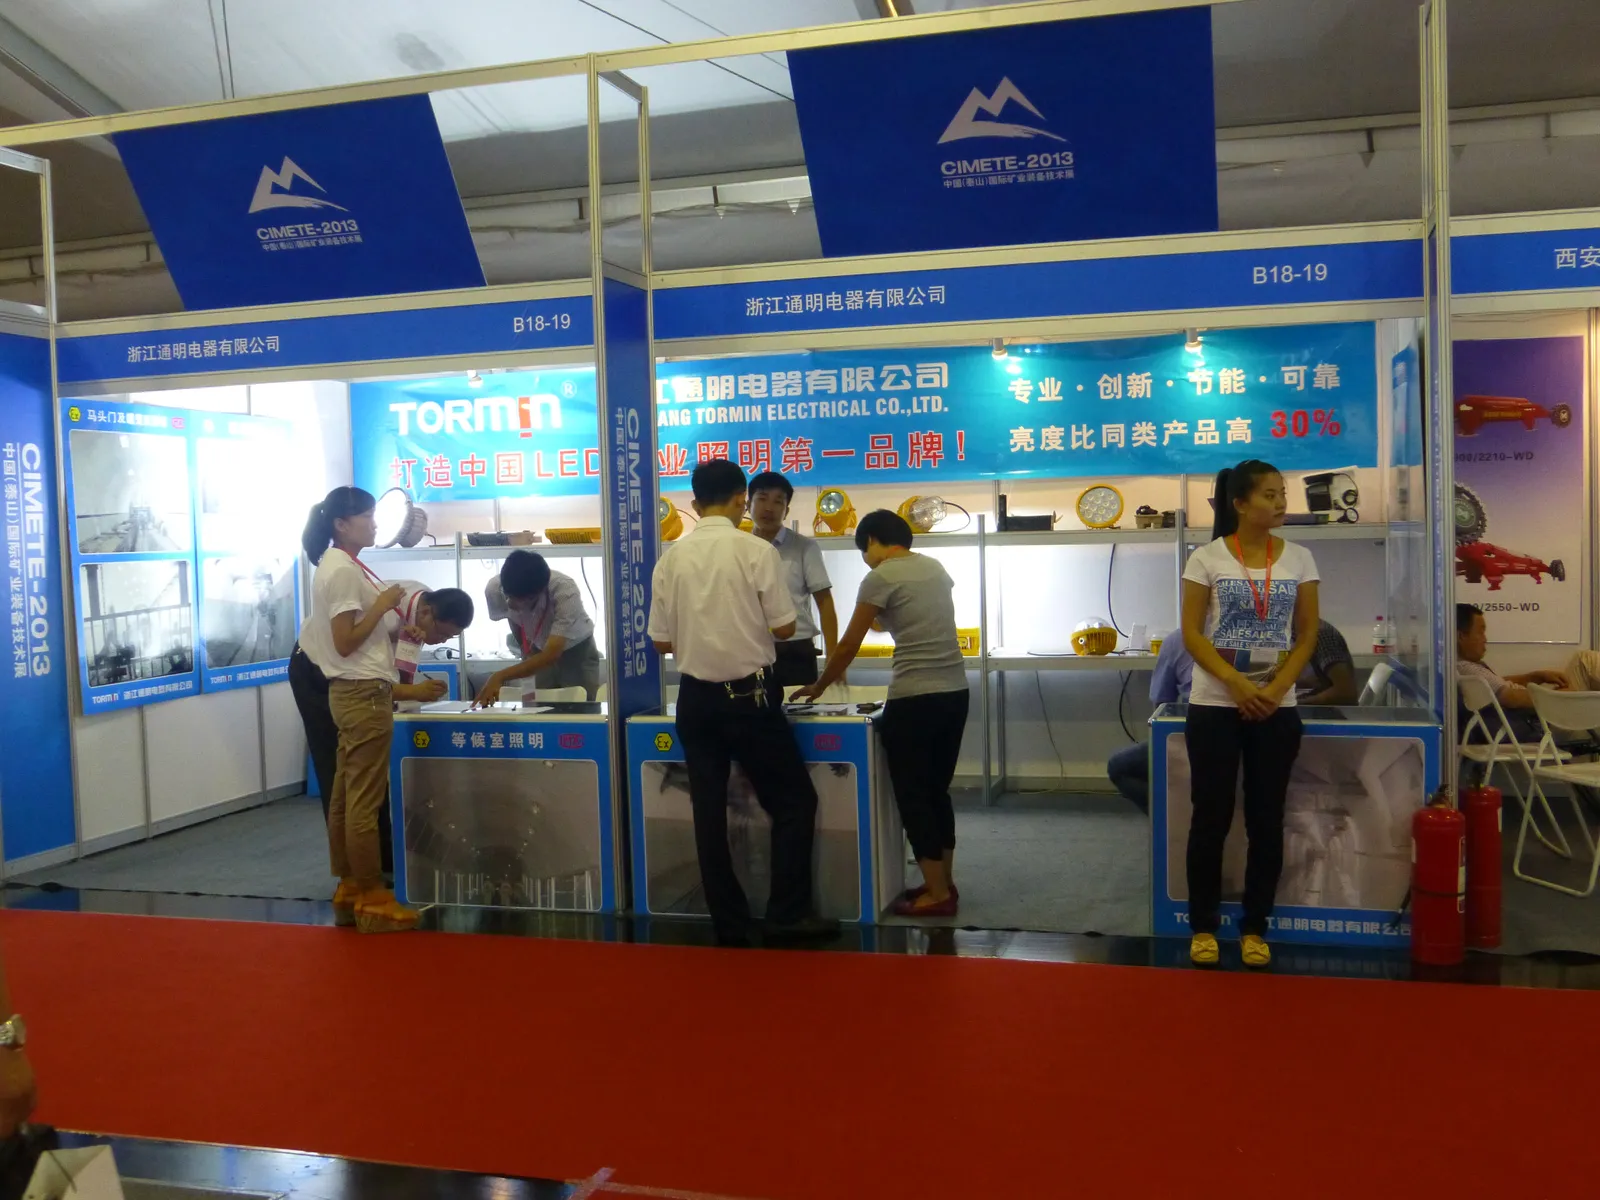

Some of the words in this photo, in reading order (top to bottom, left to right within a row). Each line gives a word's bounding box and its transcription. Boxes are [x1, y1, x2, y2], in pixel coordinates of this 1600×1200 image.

[941, 152, 1074, 175] CIMETE-2013
[256, 219, 359, 240] CIMETE-2013
[1253, 263, 1328, 284] B18-19
[746, 285, 946, 316] 浙江通明电器有限公司
[513, 313, 571, 333] B18-19
[127, 335, 280, 363] 浙江通明电器有限公司
[695, 404, 762, 424] TORMIN
[767, 399, 871, 421] ELECTRICAL
[1009, 417, 1252, 453] 亮度比同类产品高
[1269, 409, 1341, 438] 30%
[626, 408, 648, 676] CIMETE-2013
[22, 442, 51, 677] CIMETE-2013
[451, 732, 544, 749] 等候室照明
